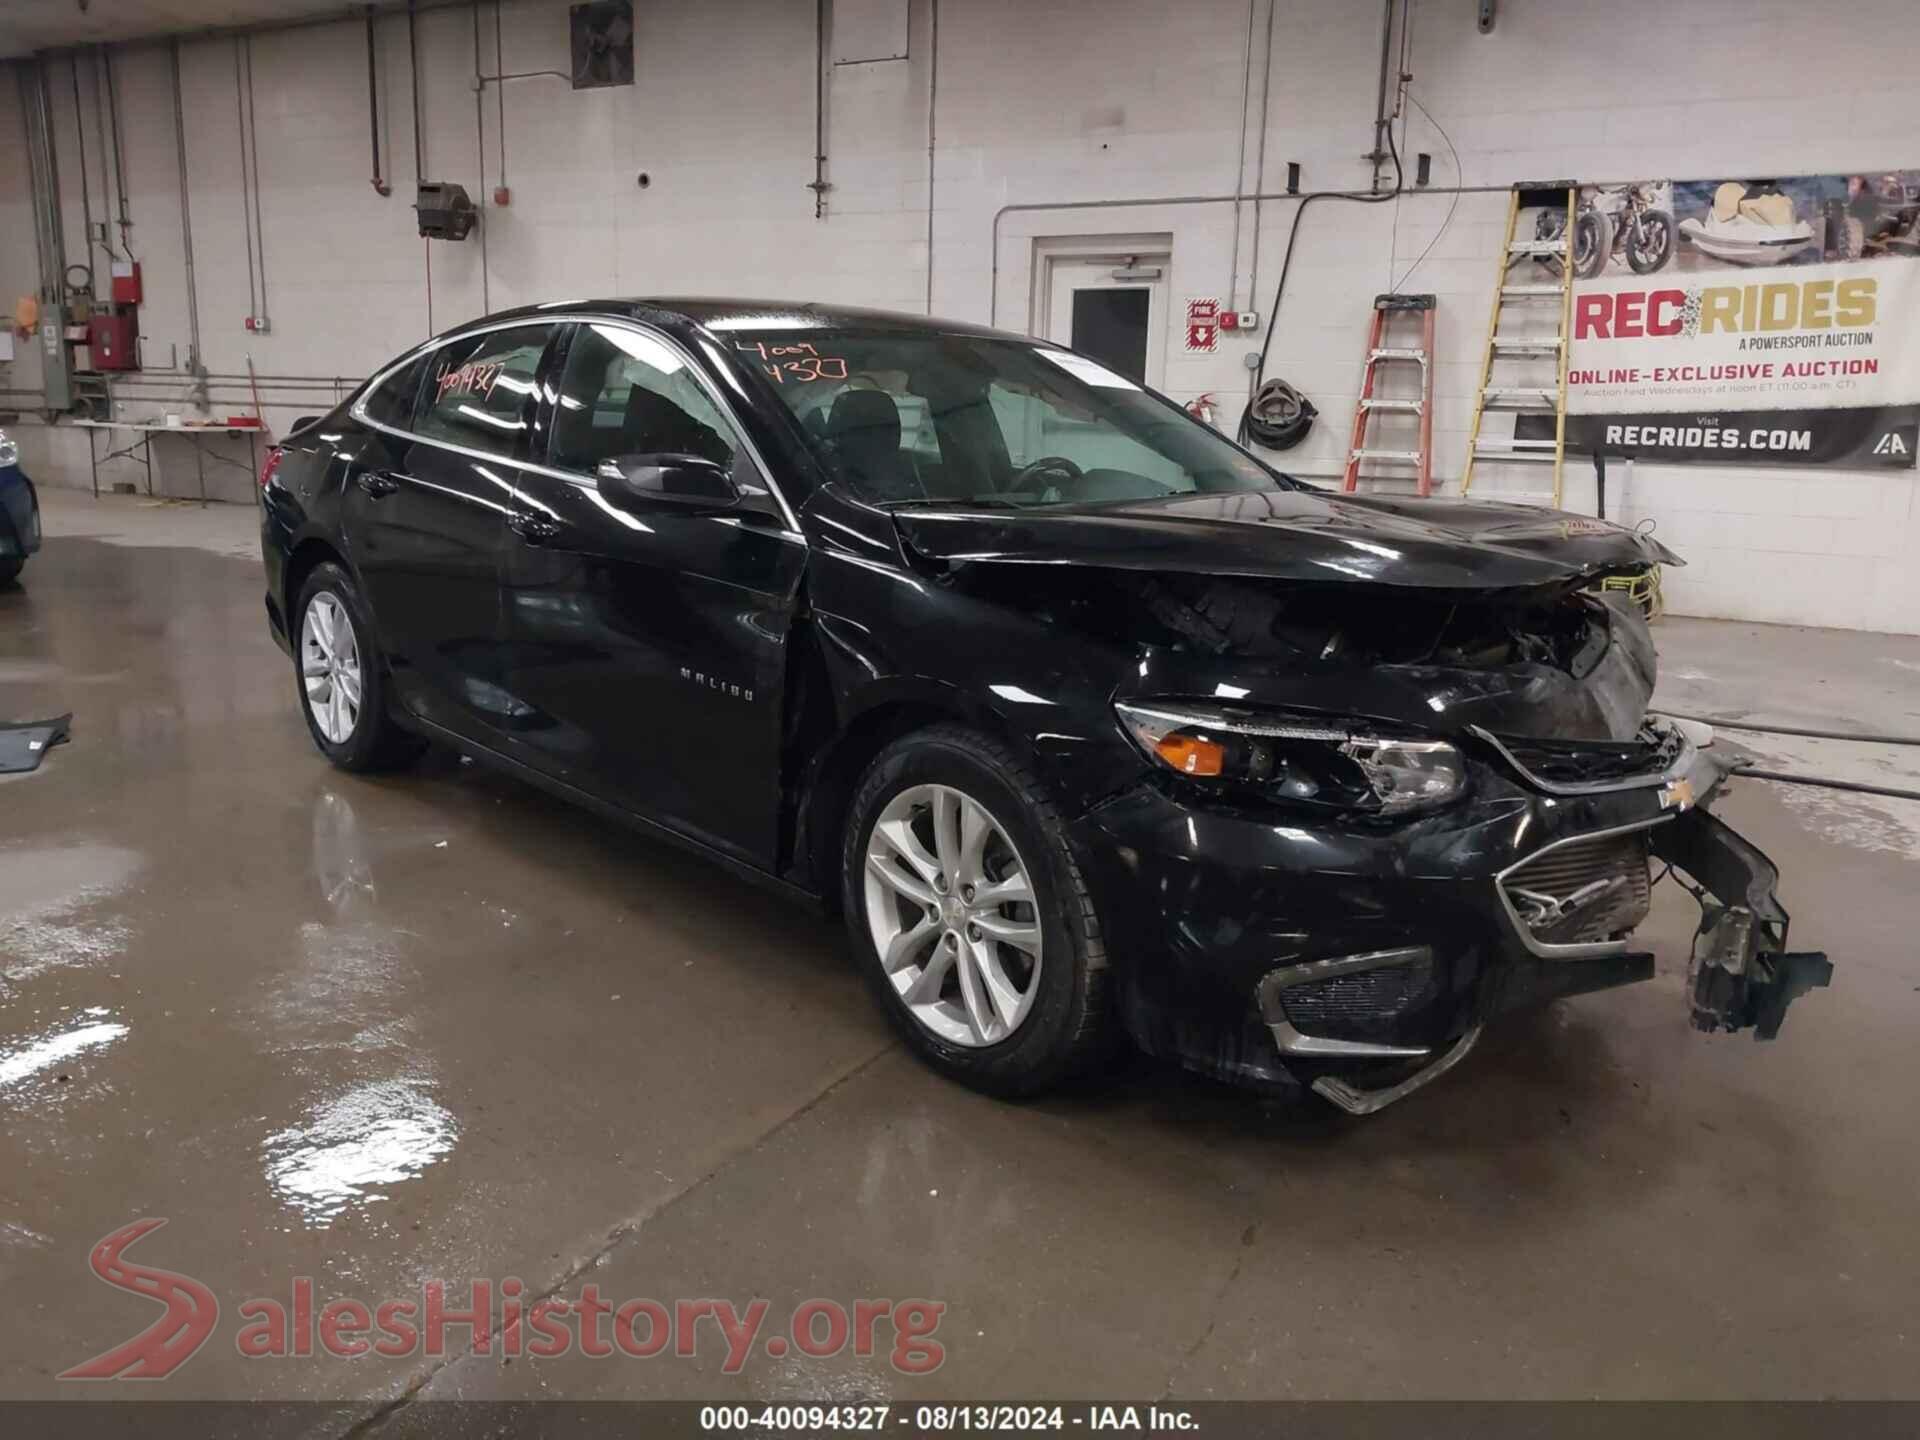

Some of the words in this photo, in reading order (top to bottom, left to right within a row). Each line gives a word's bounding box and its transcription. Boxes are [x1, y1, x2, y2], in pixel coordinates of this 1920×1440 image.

[1194, 305, 1212, 315] FIRE
[1575, 289, 1687, 339] REC
[1700, 278, 1877, 334] RIDES
[735, 340, 818, 361] 4009
[1739, 338, 1747, 351] A
[1750, 334, 1823, 350] POWERSPORT
[1825, 332, 1873, 347] AUCTION
[1568, 363, 1774, 384] ONLINE-EXCLUSIVE
[1782, 359, 1879, 377] AUCTION
[1583, 387, 1622, 398] Auction
[1649, 384, 1713, 396] Wednesdays
[1716, 384, 1726, 394] at
[1760, 382, 1775, 392] ET
[1696, 415, 1720, 426] Visit
[1605, 425, 1812, 451] RECRIDES.COM
